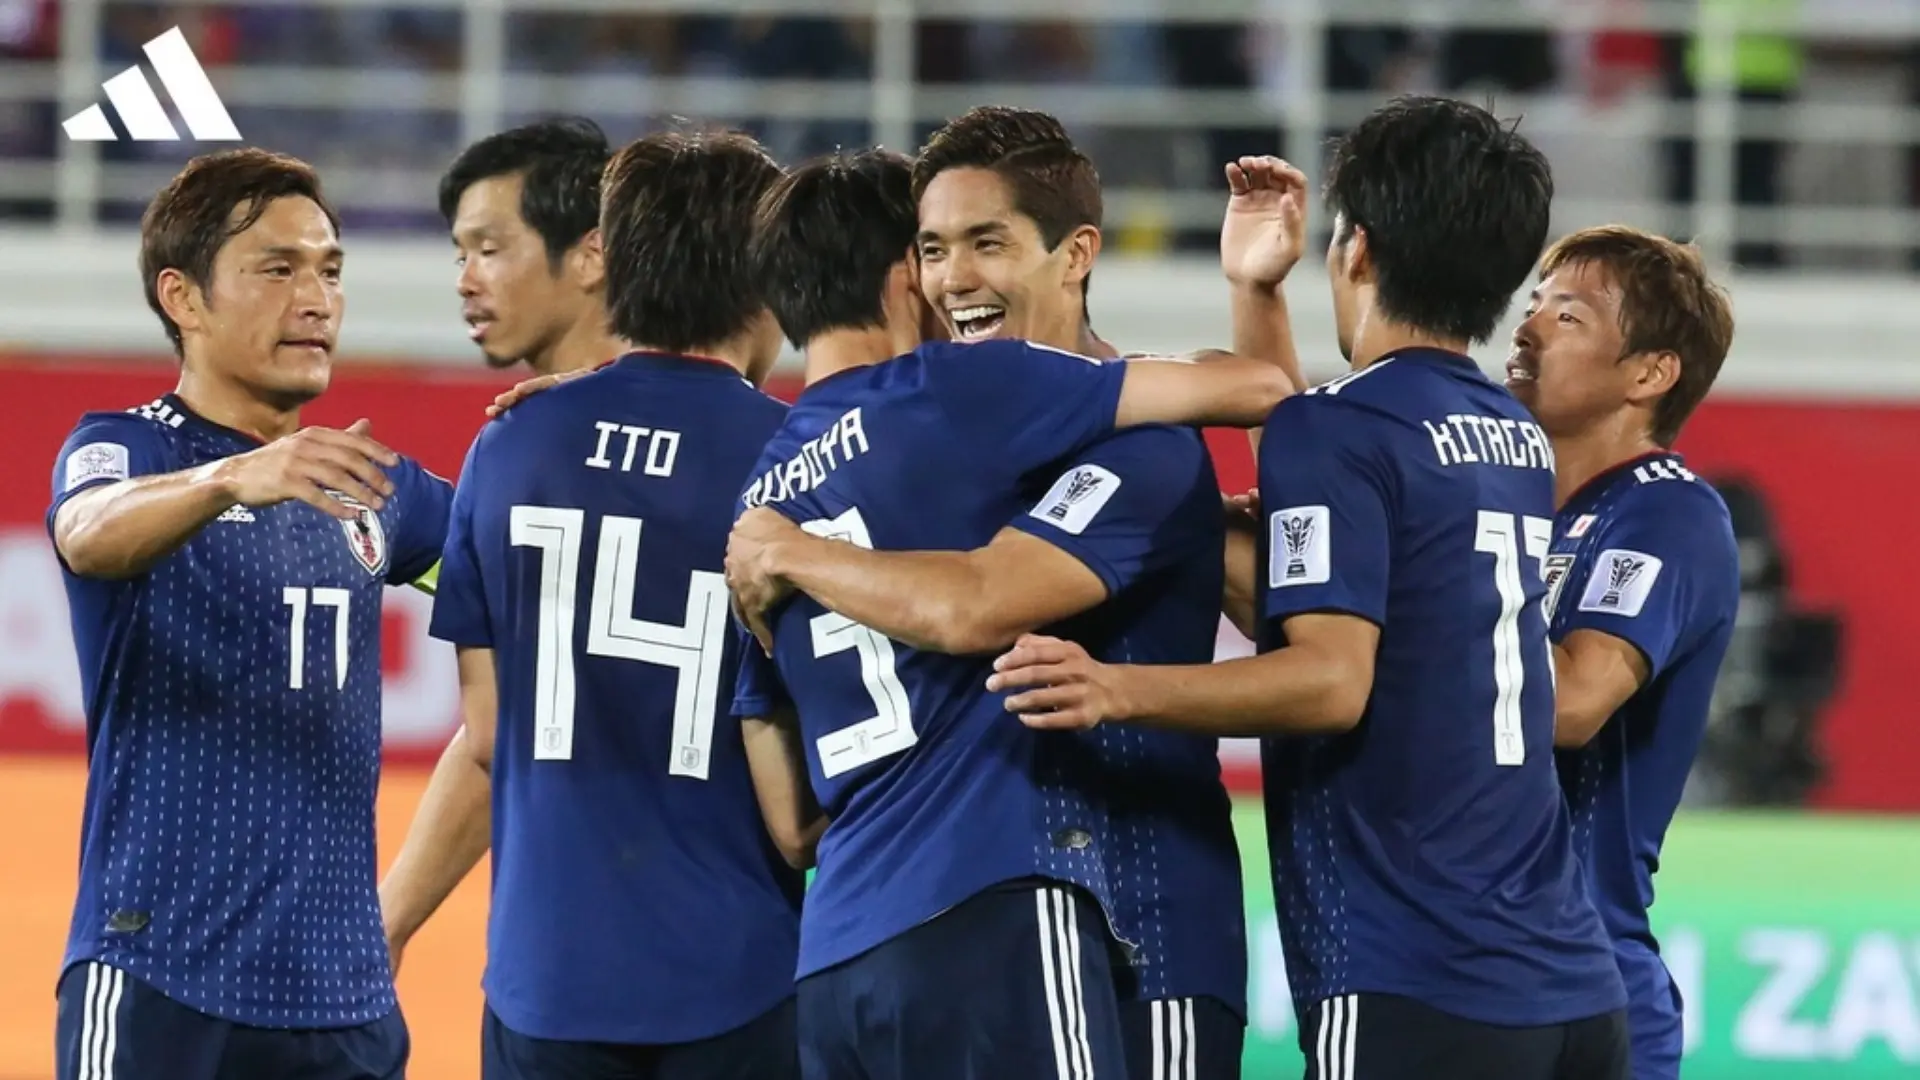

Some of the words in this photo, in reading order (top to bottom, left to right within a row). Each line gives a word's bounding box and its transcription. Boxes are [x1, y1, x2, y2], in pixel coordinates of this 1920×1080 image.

[585, 420, 681, 477] ITO
[283, 586, 350, 690] 17
[509, 505, 729, 780] 14
[800, 506, 920, 779] 3
[1734, 926, 1920, 1062] ZA
